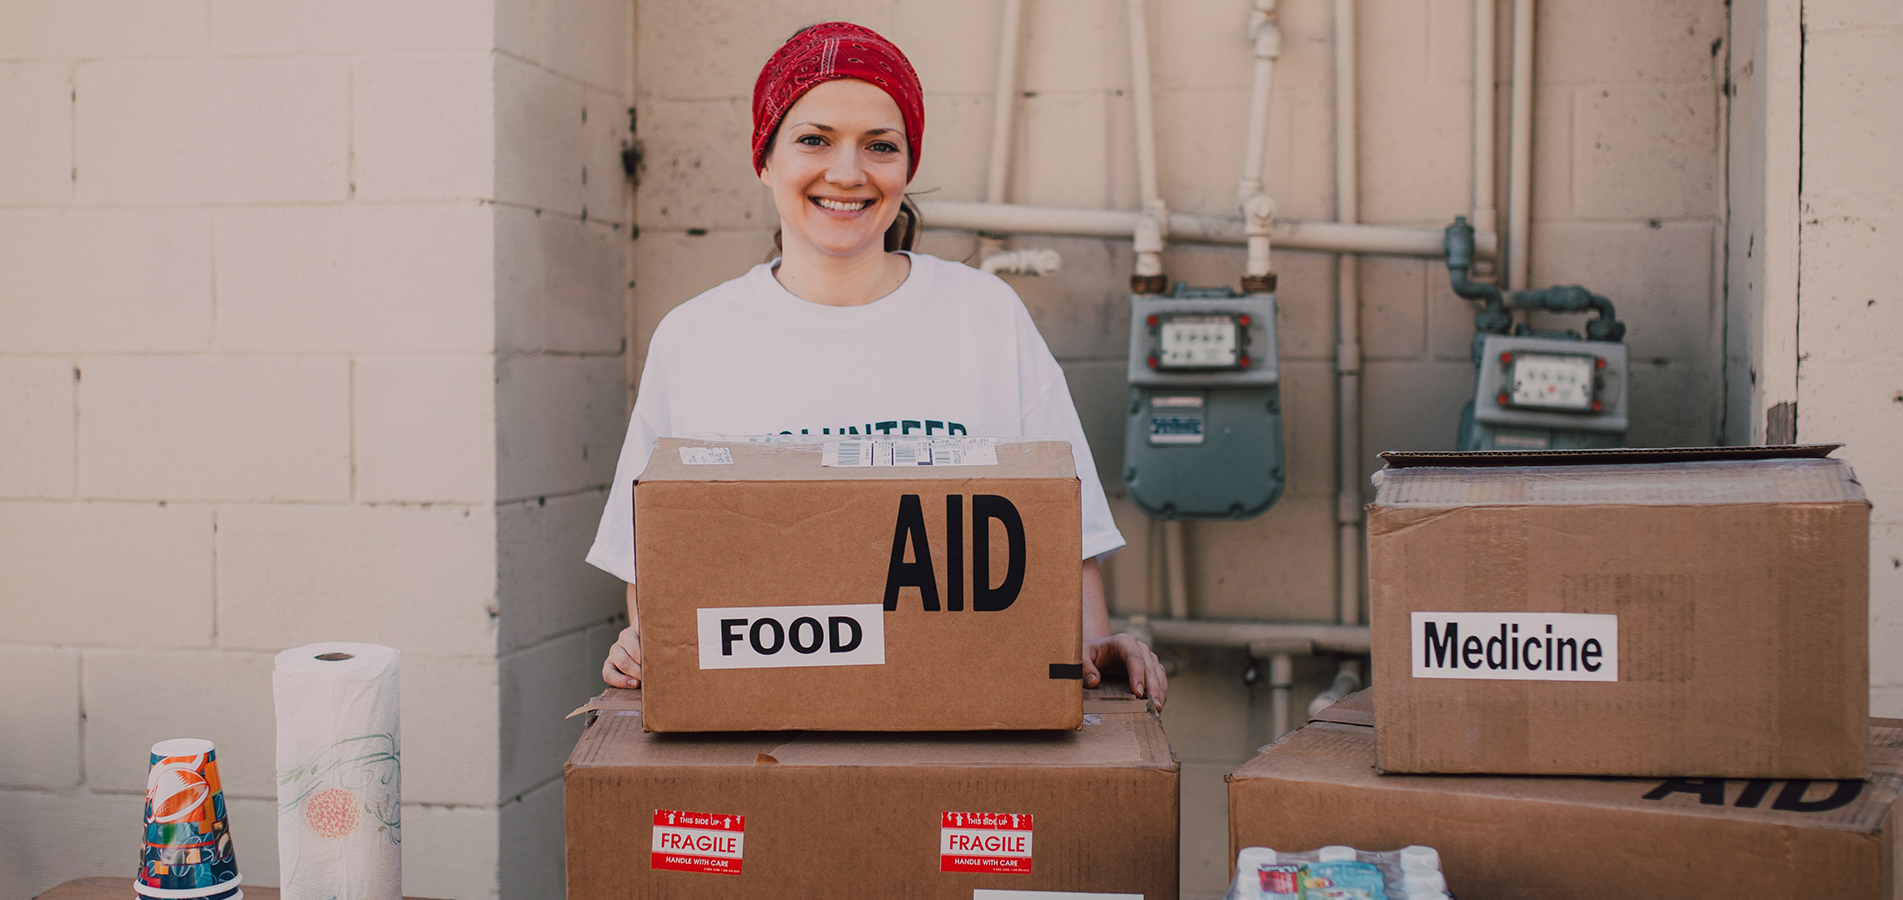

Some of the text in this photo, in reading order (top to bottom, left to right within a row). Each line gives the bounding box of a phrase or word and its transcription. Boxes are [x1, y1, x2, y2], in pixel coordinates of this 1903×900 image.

[884, 494, 1027, 612] AID
[720, 617, 863, 656] FOOD
[1424, 621, 1603, 673] Medicine
[680, 816, 693, 824] THIS
[694, 818, 709, 826] SIDE
[983, 818, 997, 826] SIDE
[661, 832, 737, 853] FRAGILE
[949, 834, 1025, 852] FRAGILE
[665, 856, 729, 868] HANDLE WITH CARE
